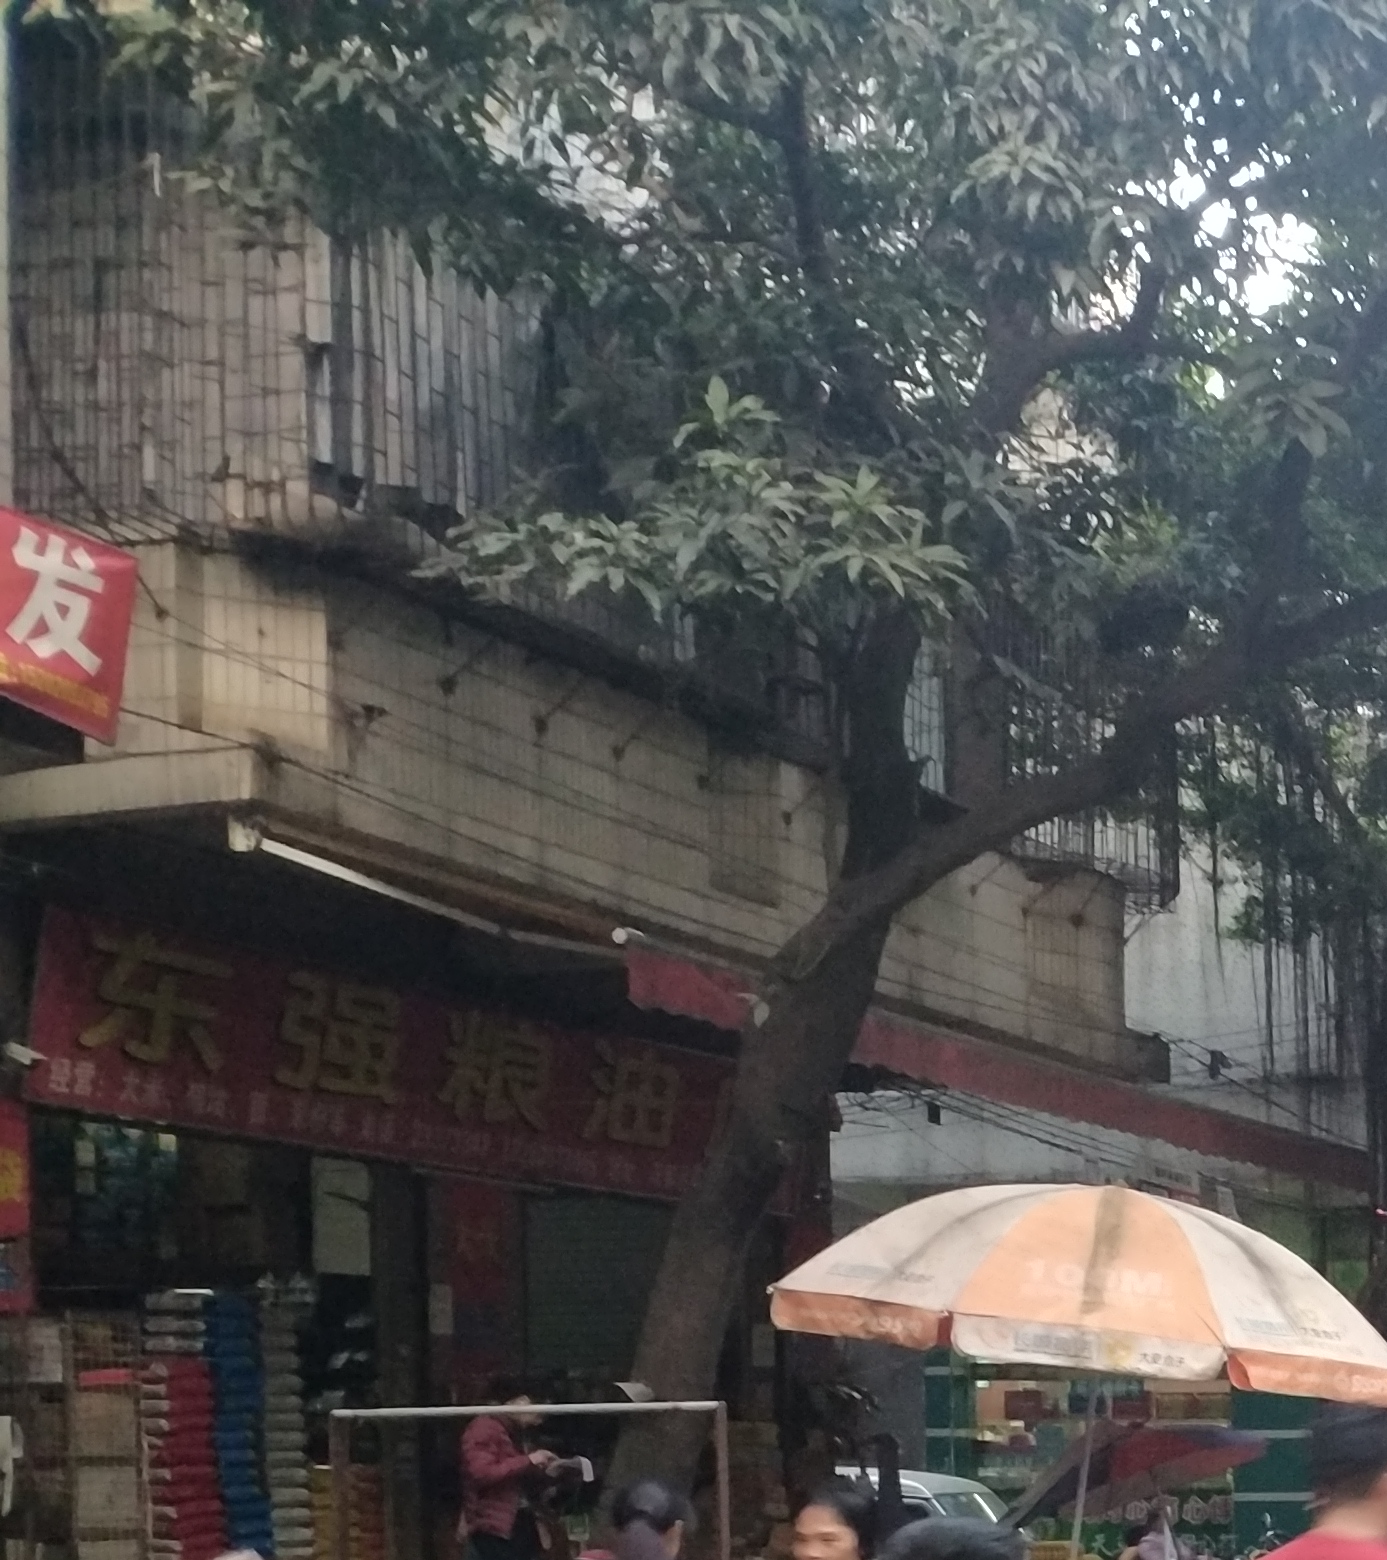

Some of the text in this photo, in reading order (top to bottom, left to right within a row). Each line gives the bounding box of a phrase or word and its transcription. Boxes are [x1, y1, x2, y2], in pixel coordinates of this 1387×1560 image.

[4, 525, 106, 677] 发
[78, 929, 735, 1155] 东强粮油
